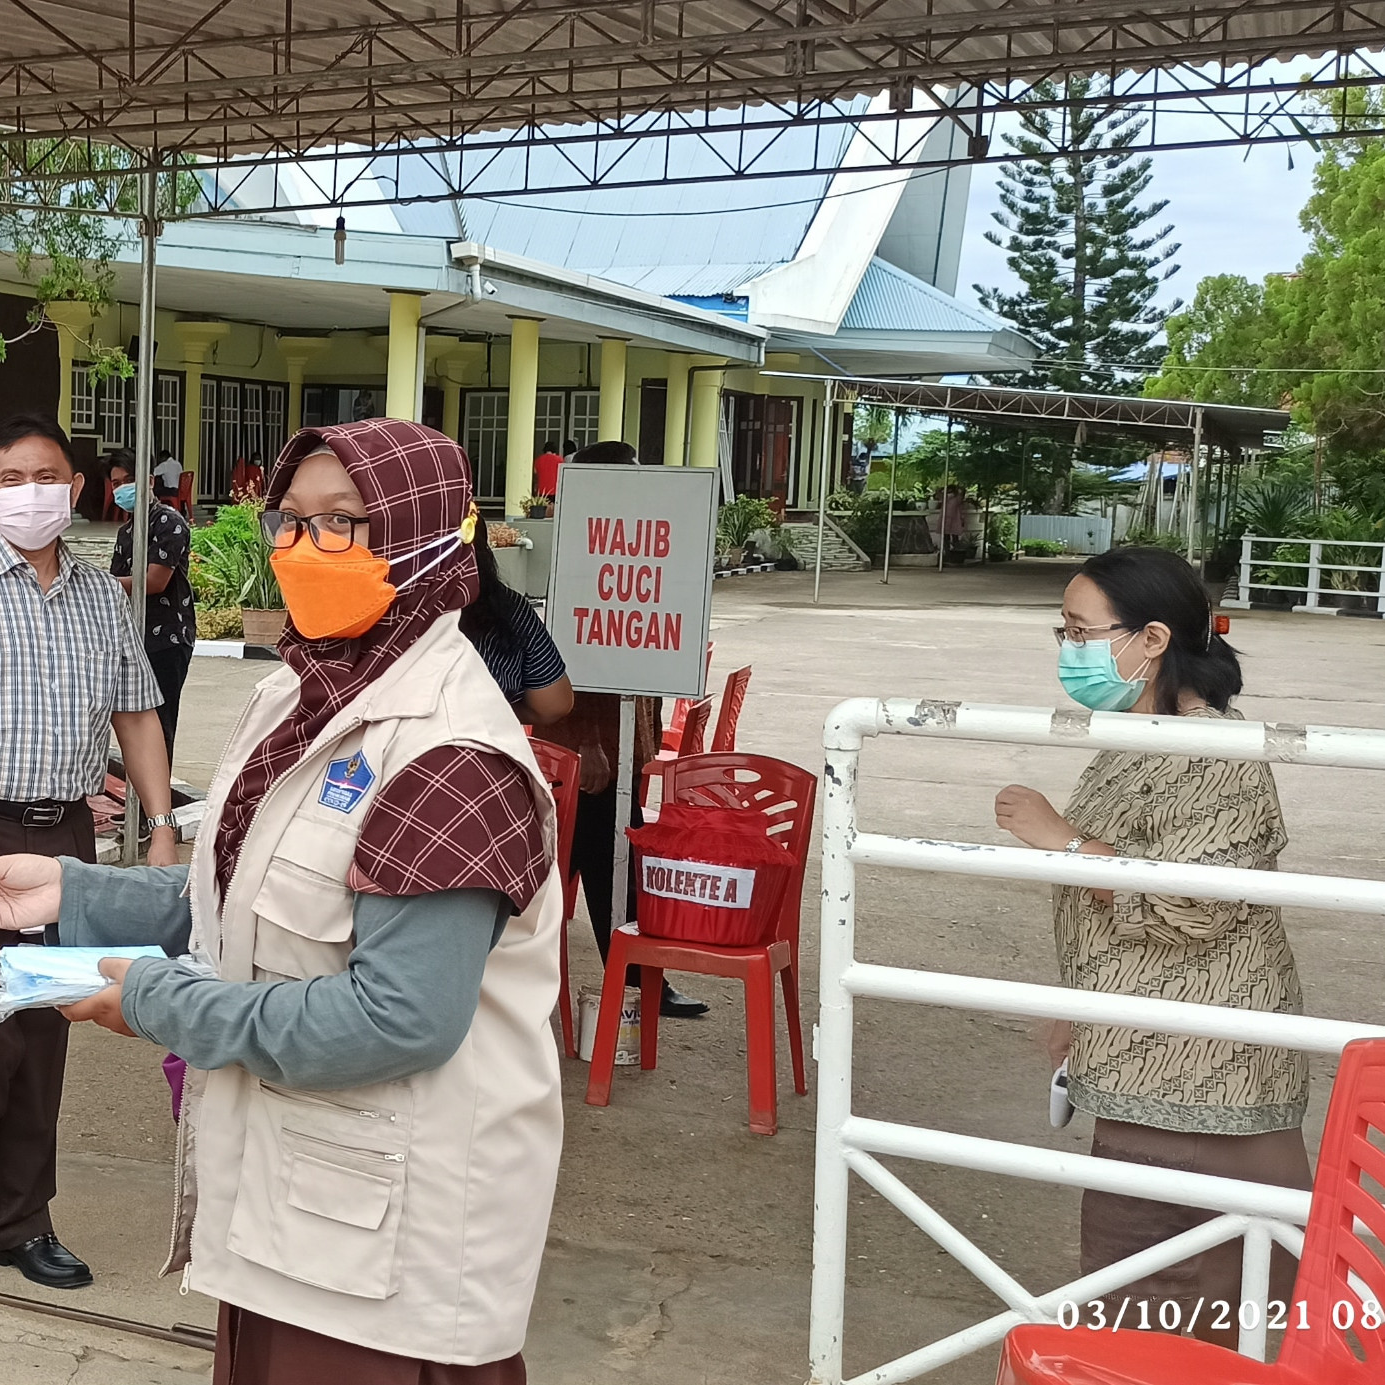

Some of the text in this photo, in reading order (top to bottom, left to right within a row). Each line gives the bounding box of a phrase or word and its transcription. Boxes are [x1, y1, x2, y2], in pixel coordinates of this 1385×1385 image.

[587, 517, 671, 558] WAJIB
[597, 563, 663, 604] CUCI
[573, 607, 682, 651] TANGAN
[723, 877, 738, 903] A
